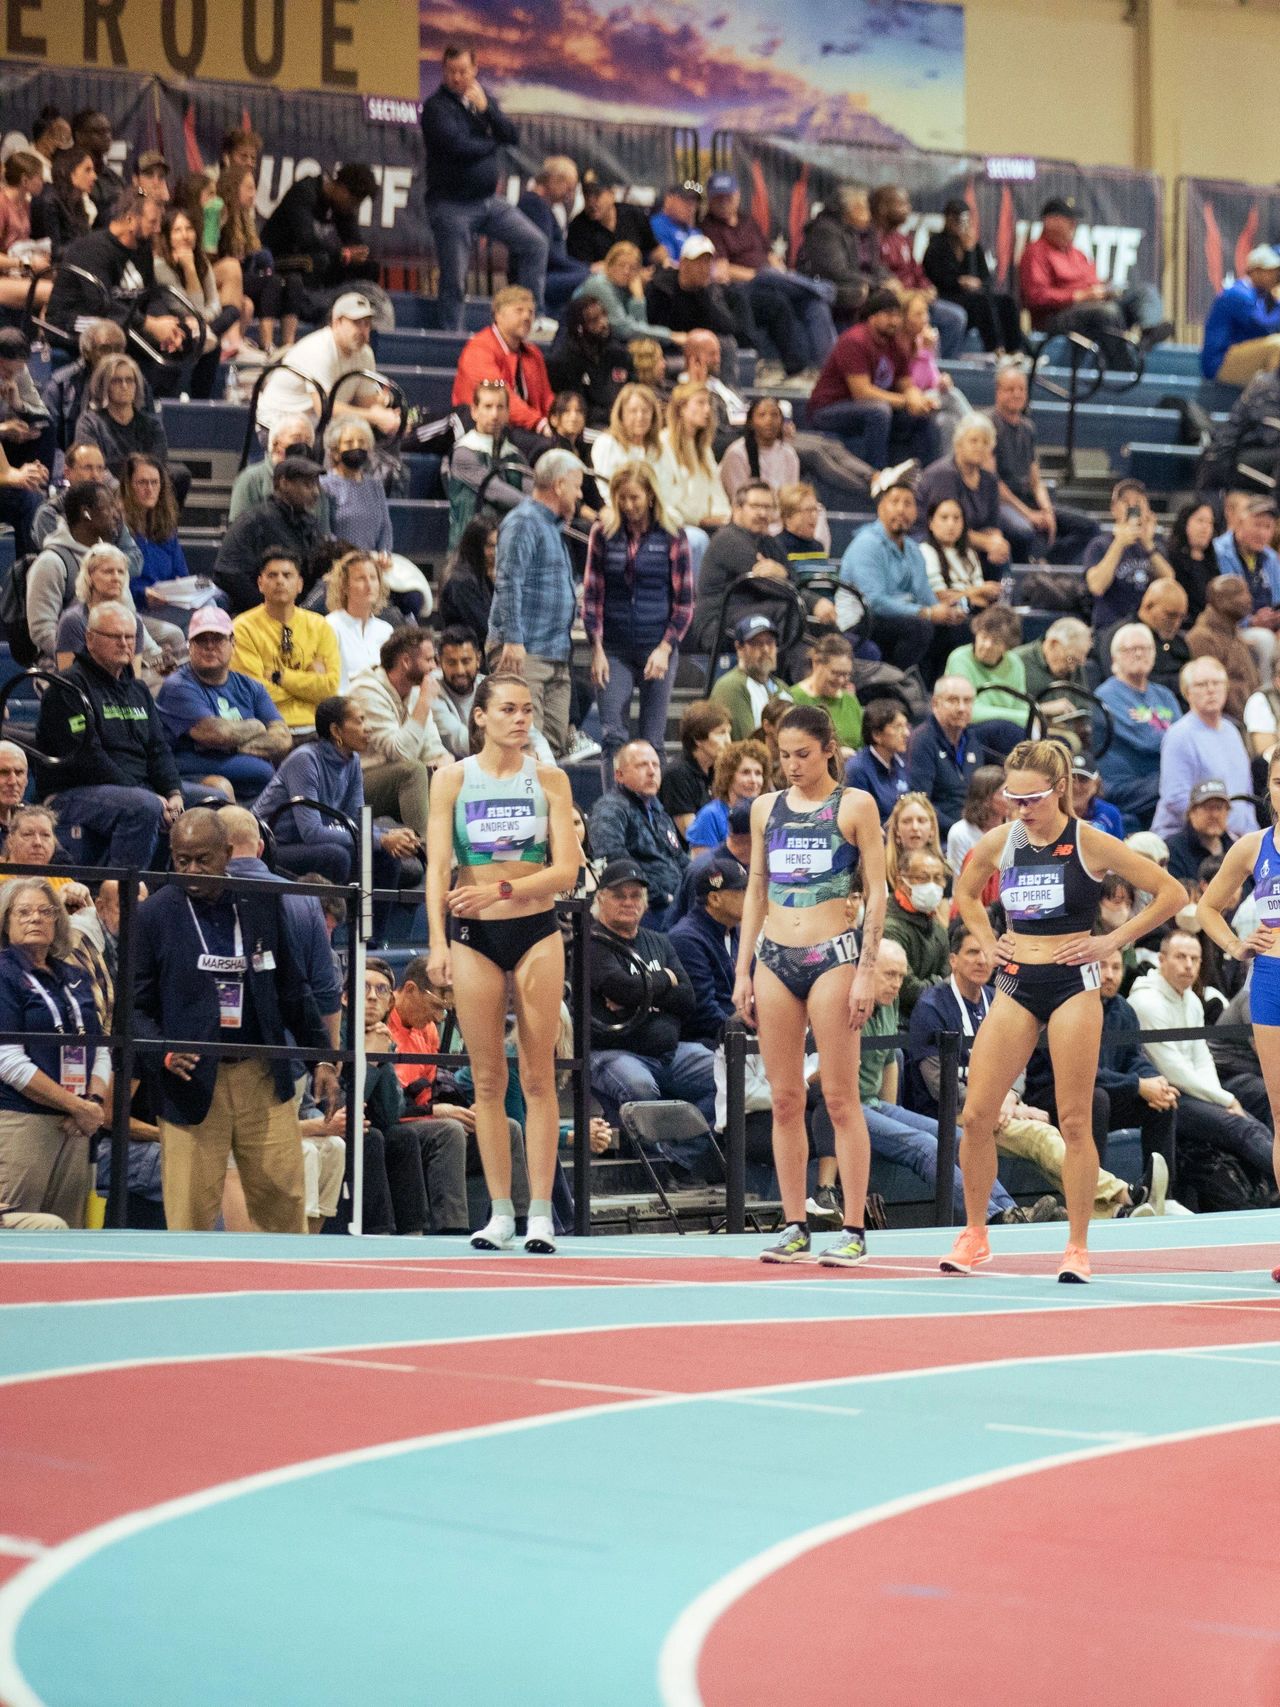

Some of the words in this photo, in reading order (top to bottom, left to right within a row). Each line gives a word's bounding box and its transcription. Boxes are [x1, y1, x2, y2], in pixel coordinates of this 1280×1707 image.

[368, 97, 418, 124] SECTION
[487, 805, 532, 818] ABQ'24
[480, 821, 520, 833] ANDREWS
[787, 837, 828, 849] ABQ'24
[785, 853, 812, 865] HENES
[1018, 873, 1060, 886] ABQ'24
[1023, 889, 1052, 901] PIERRE
[836, 934, 857, 961] 12
